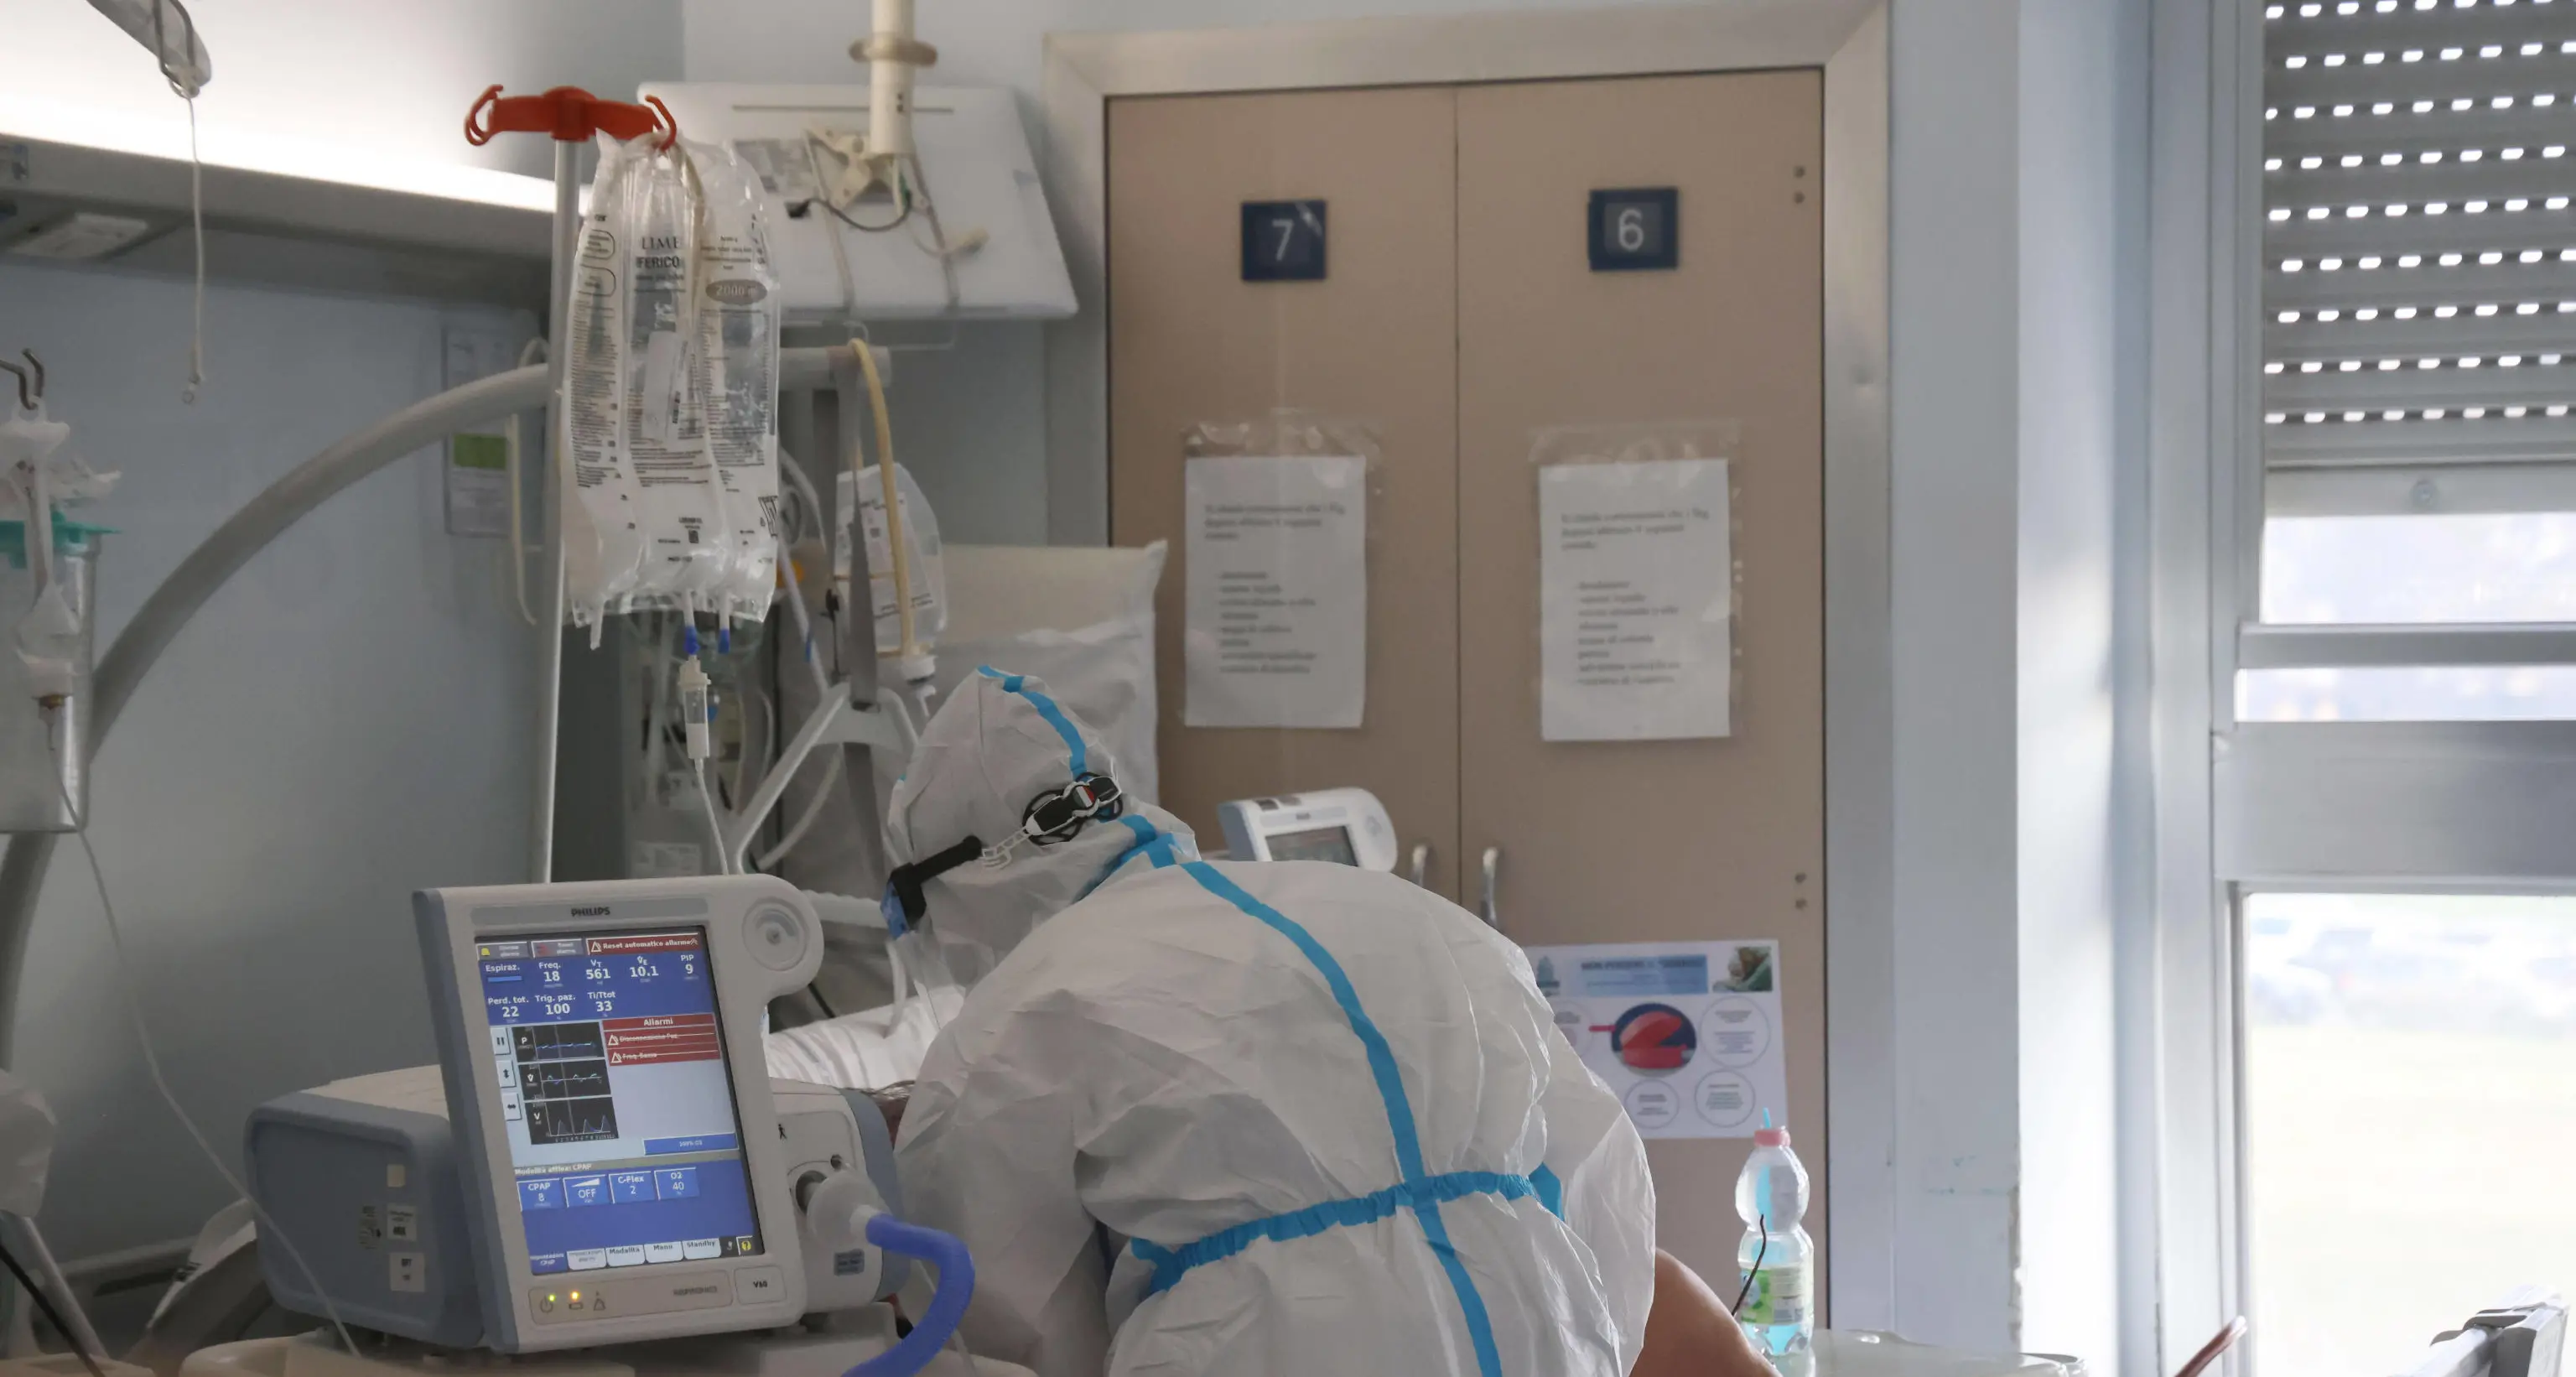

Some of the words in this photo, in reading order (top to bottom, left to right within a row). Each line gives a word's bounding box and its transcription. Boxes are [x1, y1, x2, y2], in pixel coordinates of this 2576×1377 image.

[1618, 209, 1644, 251] 6
[1272, 219, 1295, 261] 7
[571, 907, 610, 917] PHILIPS
[625, 940, 663, 948] automatico
[486, 964, 521, 973] Espiraz.
[538, 961, 562, 970] Freq.
[685, 964, 693, 974] 9
[543, 970, 560, 982] 18
[585, 968, 610, 979] 561
[630, 965, 659, 978] 10.1
[488, 996, 512, 1005] Perd.
[513, 995, 529, 1004] tot.
[535, 995, 555, 1003] Trig.
[558, 994, 576, 1002] paz.
[545, 1003, 570, 1015] 100
[595, 1000, 612, 1011] 33
[501, 1006, 519, 1017] 22
[643, 1017, 673, 1026] Allarmi
[618, 1175, 645, 1183] C-Flex
[527, 1182, 551, 1191] CPAP
[630, 1186, 636, 1194] 2
[673, 1182, 684, 1190] 40
[538, 1193, 545, 1202] 8
[578, 1188, 596, 1198] OFF
[687, 1240, 716, 1249] Standby
